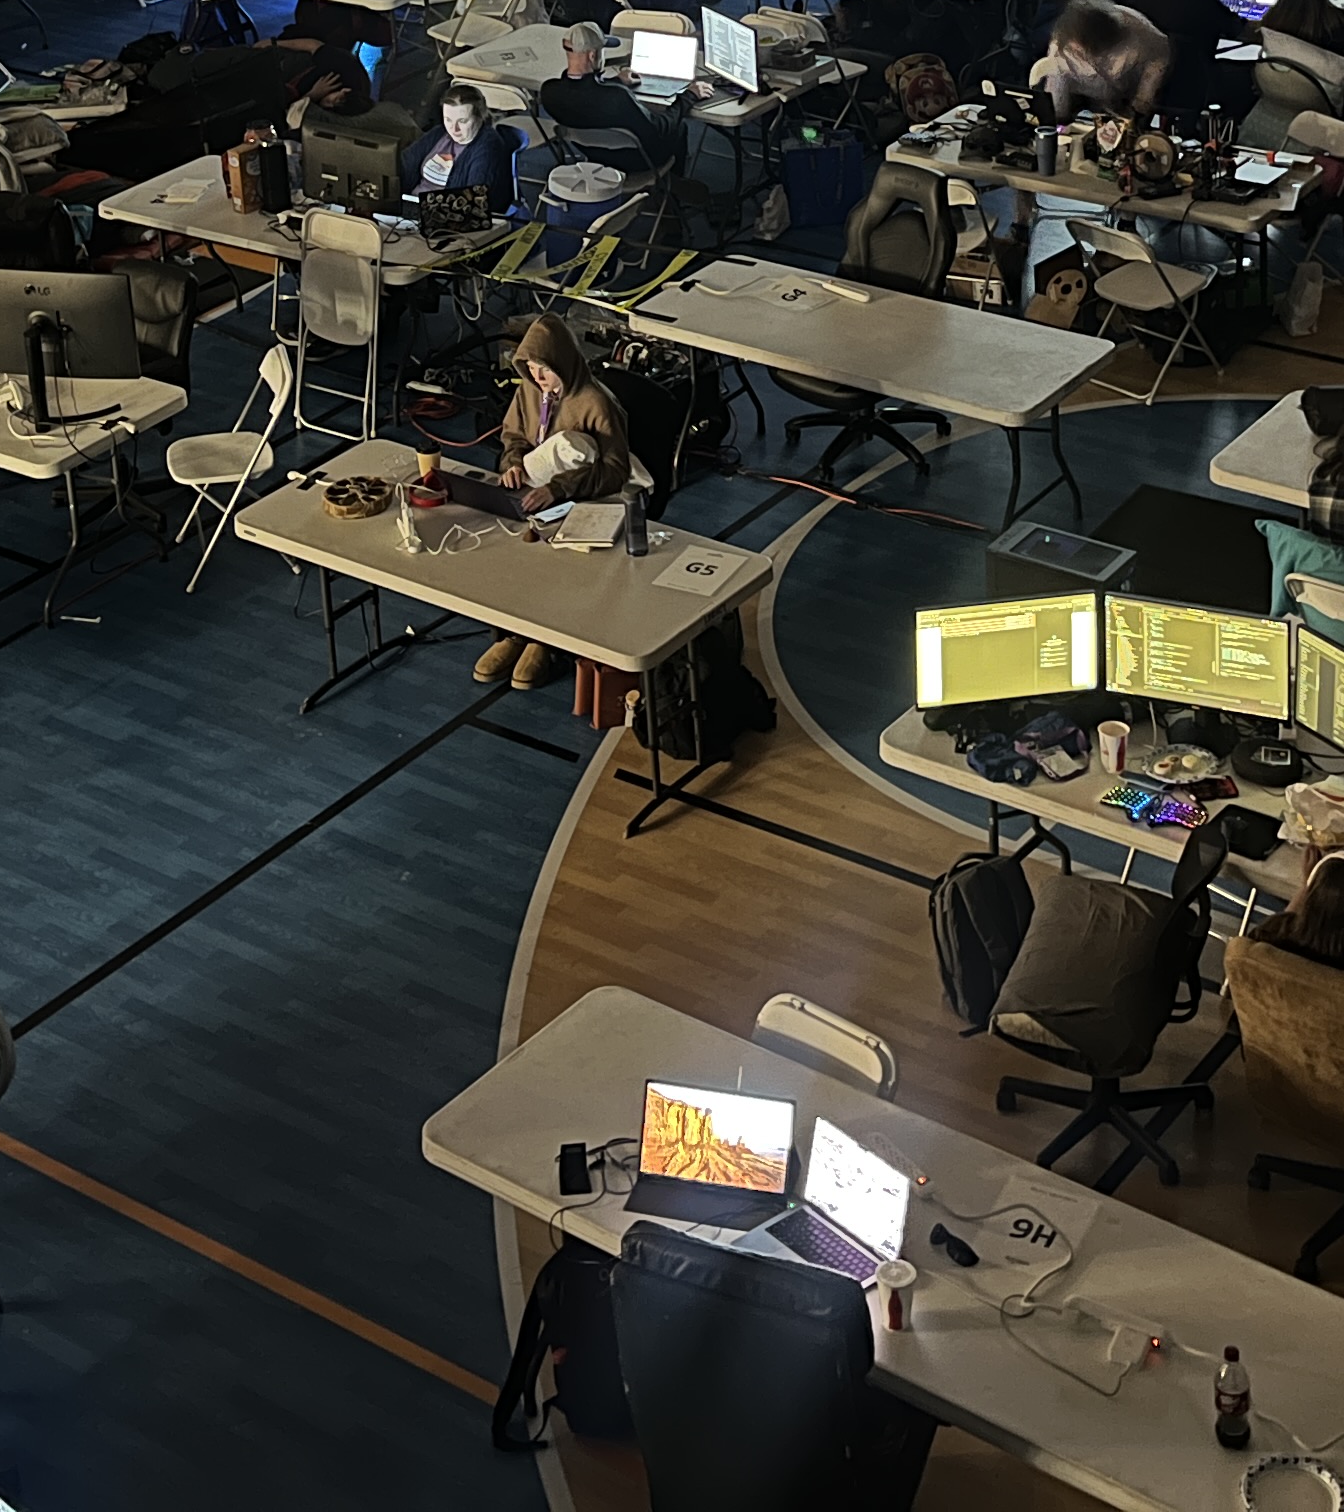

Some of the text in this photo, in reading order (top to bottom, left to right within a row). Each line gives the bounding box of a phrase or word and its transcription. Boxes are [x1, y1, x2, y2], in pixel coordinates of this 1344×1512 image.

[781, 288, 808, 302] G4
[685, 561, 719, 576] G5
[1009, 1218, 1058, 1249] H6
